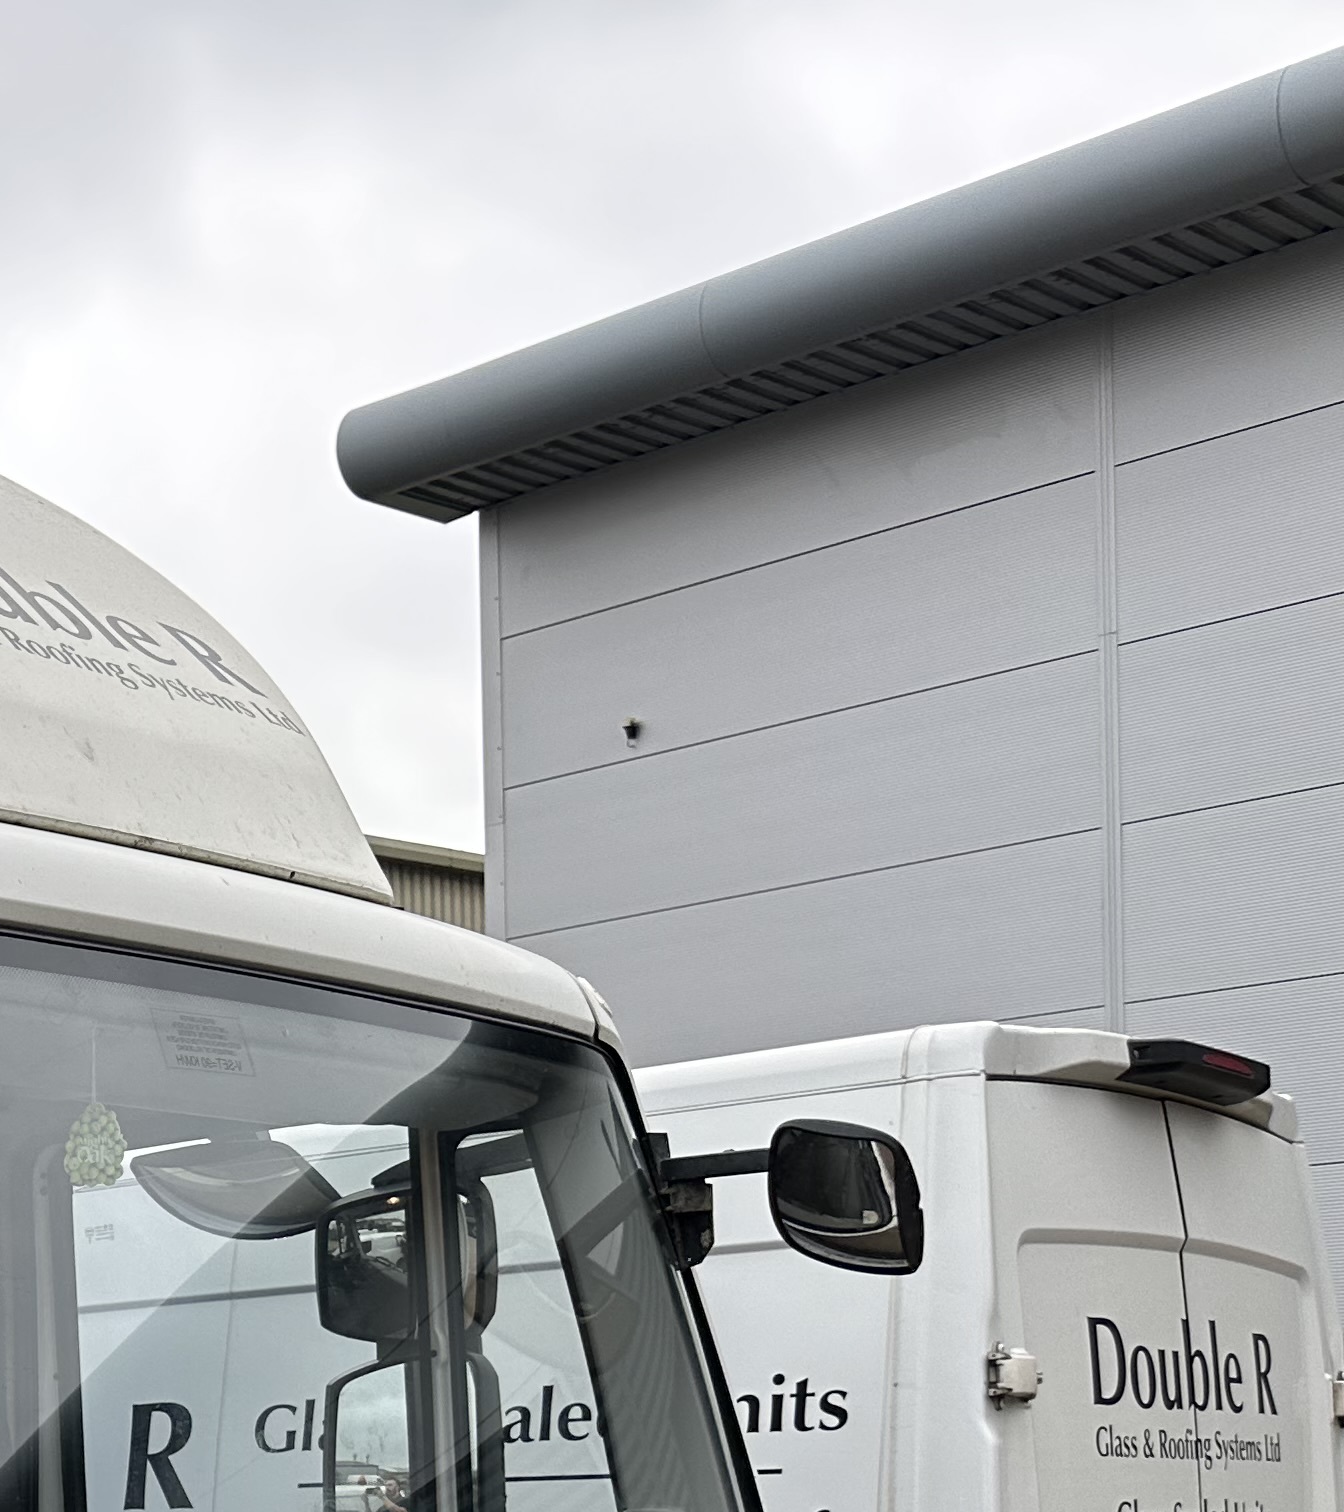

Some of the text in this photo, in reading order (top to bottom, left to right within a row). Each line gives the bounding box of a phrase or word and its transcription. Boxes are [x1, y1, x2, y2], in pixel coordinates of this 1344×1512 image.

[156, 620, 268, 699] R
[127, 662, 256, 719] Systems
[249, 700, 306, 736] Ltd
[736, 1373, 849, 1433] nits
[1086, 1316, 1278, 1416] Double R
[123, 1402, 194, 1510] R
[1095, 1424, 1282, 1470] Glass & Roofing Systems Ltd
